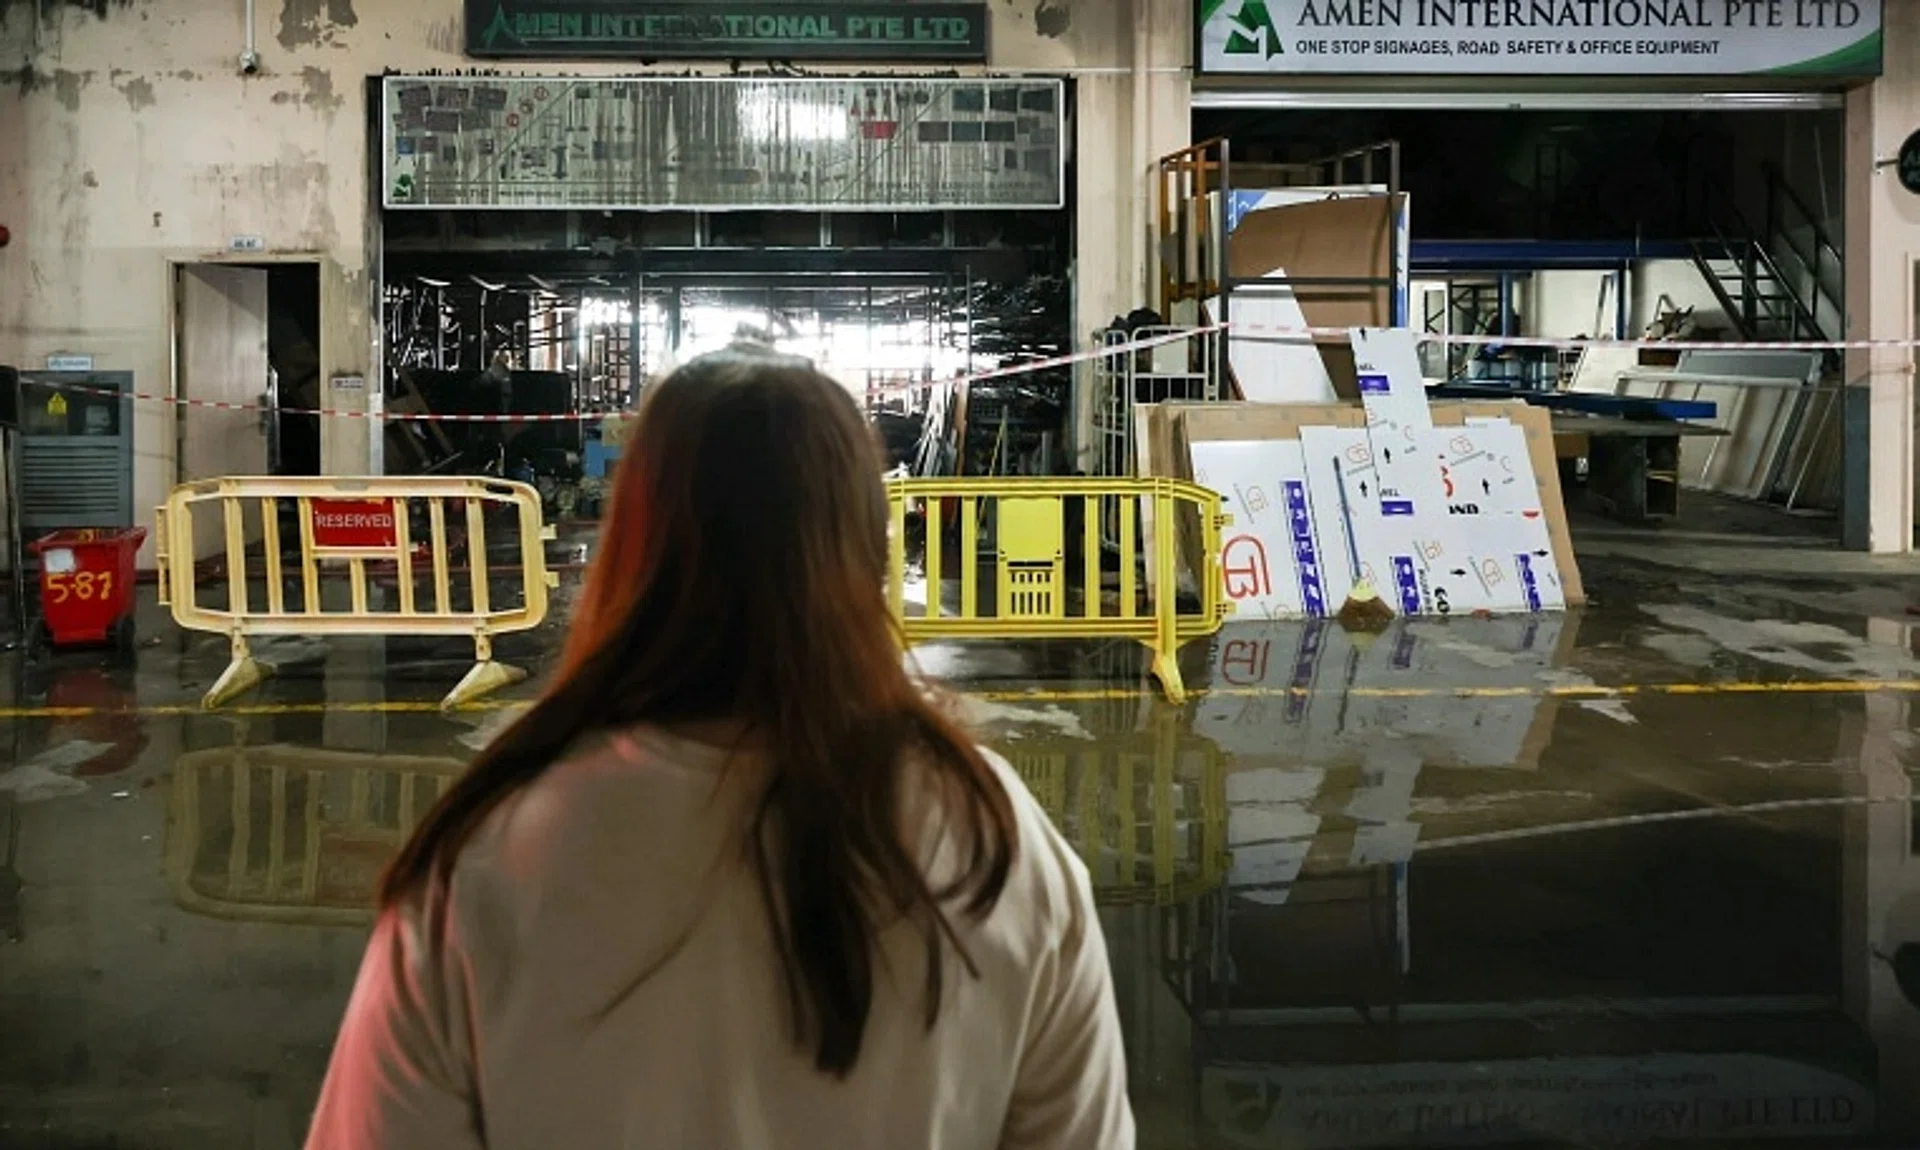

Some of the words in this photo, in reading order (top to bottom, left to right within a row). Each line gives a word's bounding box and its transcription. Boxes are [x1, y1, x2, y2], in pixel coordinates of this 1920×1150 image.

[1296, 0, 1402, 26] AMEN
[1415, 0, 1713, 27] INTERNATIONAL
[1723, 1, 1783, 27] PTE
[1795, 1, 1860, 28] LTD
[480, 5, 583, 47] AMEN
[847, 16, 904, 40] PTE
[912, 17, 971, 40] LTD
[1296, 40, 1327, 55] ONE
[1330, 40, 1370, 55] STOP
[1373, 40, 1453, 57] SIGNAGES,
[1456, 41, 1500, 55] ROAD
[1506, 40, 1562, 55] SAFETY
[1565, 41, 1577, 55] &
[1580, 40, 1632, 55] OFFICE
[1635, 40, 1720, 55] EQUIPMENT
[314, 513, 392, 529] RESERVED
